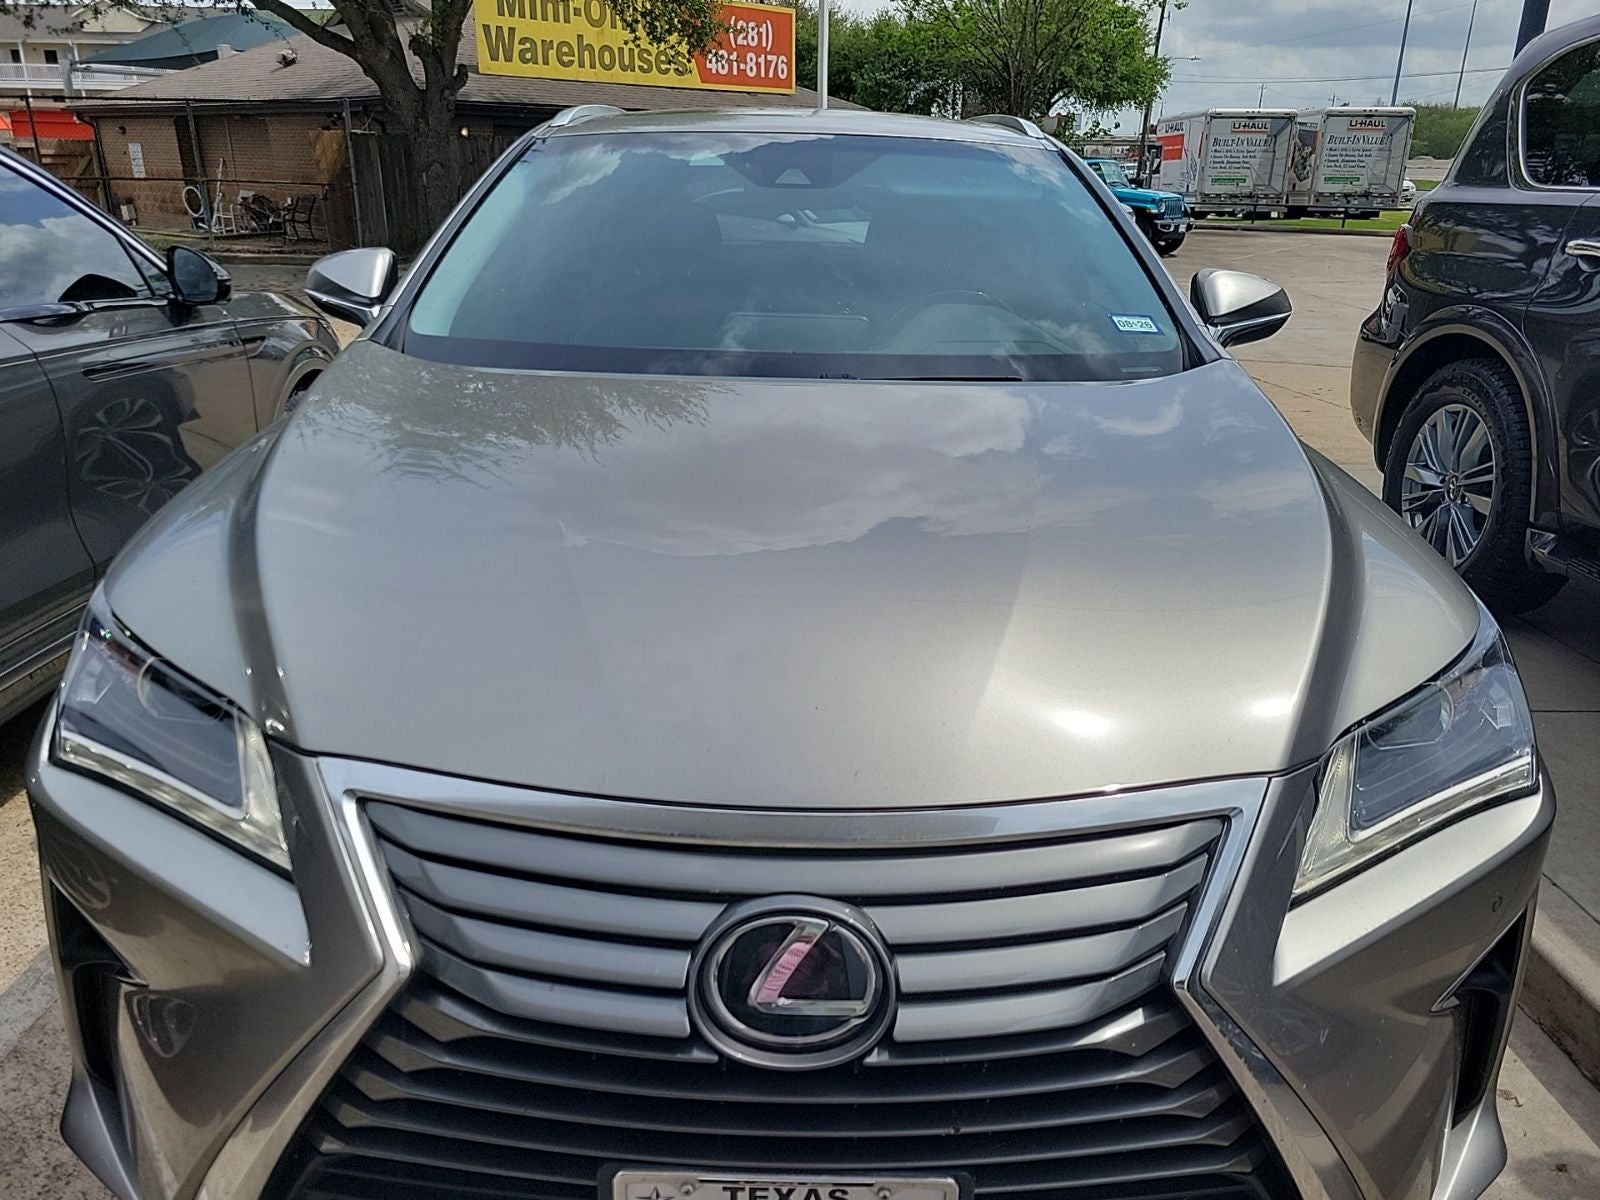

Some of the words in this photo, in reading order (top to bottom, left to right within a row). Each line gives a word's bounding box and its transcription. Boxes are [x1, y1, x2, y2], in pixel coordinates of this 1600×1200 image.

[496, 0, 630, 30] Mini-O
[729, 15, 773, 52] (281)
[481, 24, 690, 77] Warehouses
